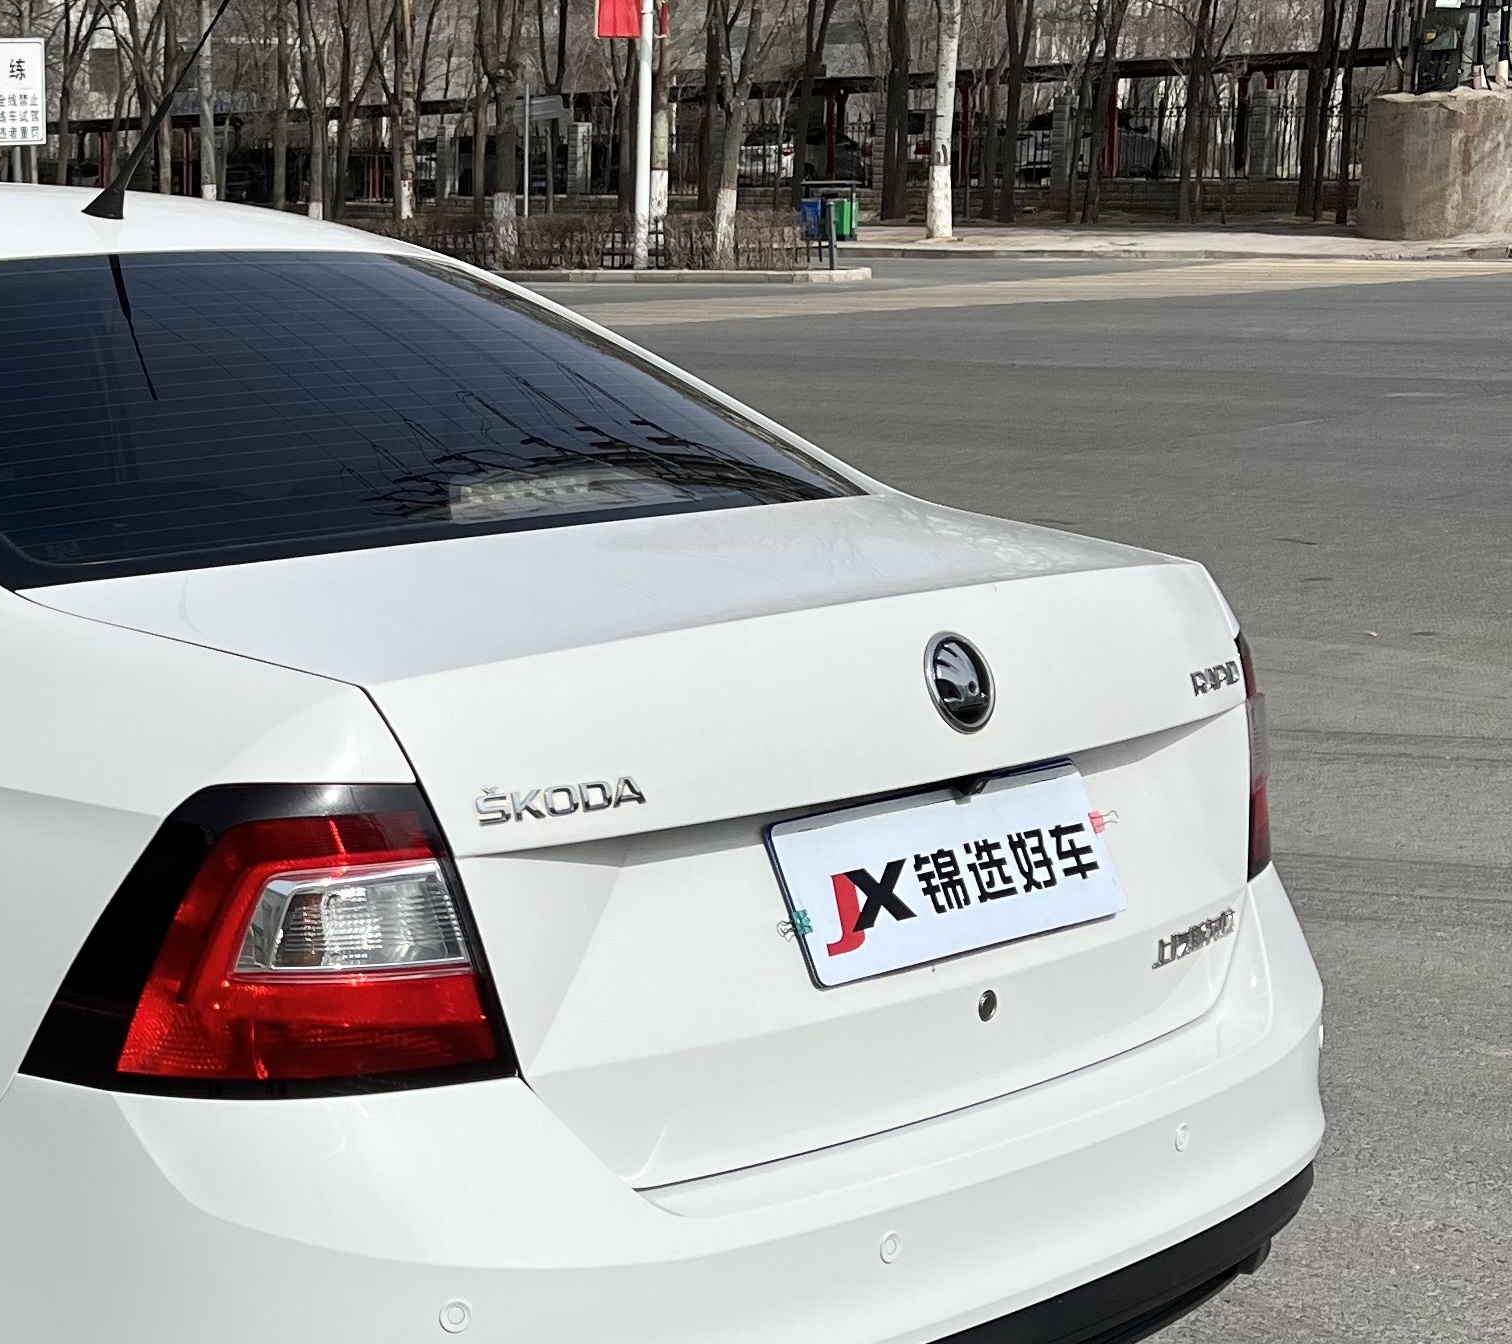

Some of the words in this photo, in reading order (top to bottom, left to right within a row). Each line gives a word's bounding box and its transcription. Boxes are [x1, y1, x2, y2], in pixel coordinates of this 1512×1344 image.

[9, 58, 26, 80] 练
[1190, 660, 1240, 697] RAPID
[475, 776, 647, 827] ŠKODA
[826, 858, 917, 957] JX
[913, 822, 1100, 914] 锦选好车
